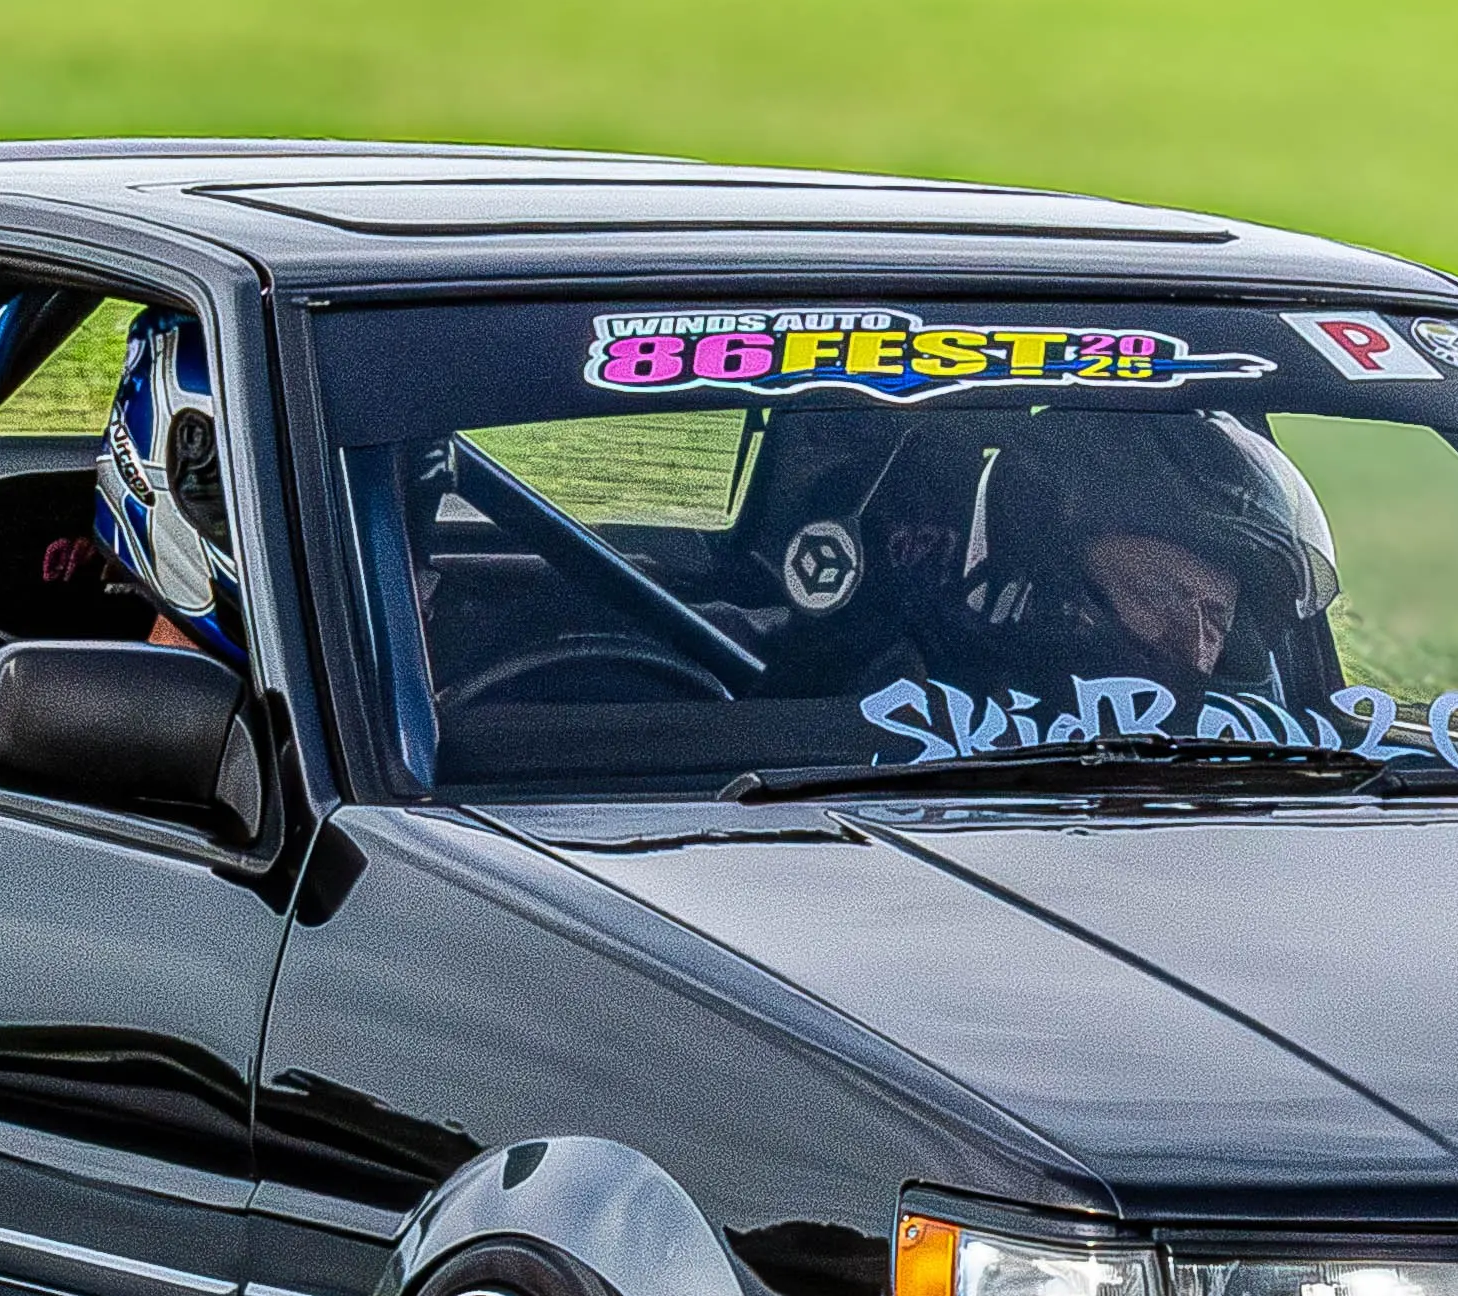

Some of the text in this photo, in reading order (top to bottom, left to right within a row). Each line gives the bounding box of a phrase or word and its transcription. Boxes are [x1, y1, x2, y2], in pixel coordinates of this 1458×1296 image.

[612, 312, 892, 336] WINDS AUTO
[1315, 320, 1391, 370] P
